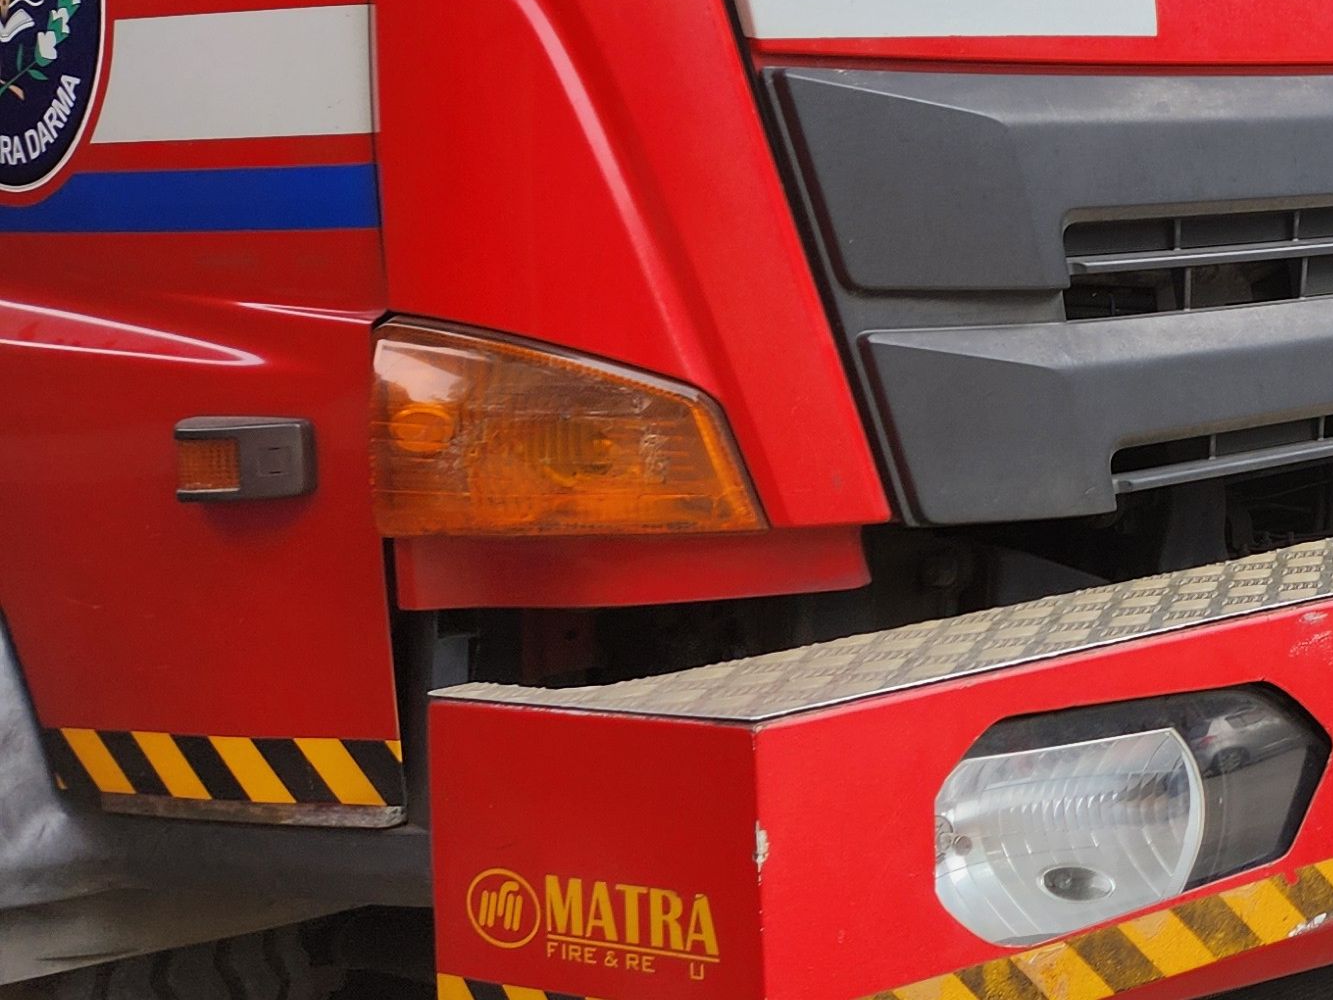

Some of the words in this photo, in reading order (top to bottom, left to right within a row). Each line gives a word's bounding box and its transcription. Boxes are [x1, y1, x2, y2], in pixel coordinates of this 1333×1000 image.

[24, 74, 81, 160] DARMA
[545, 874, 720, 956] MATRA
[546, 941, 598, 965] FIRE
[603, 950, 619, 968] &
